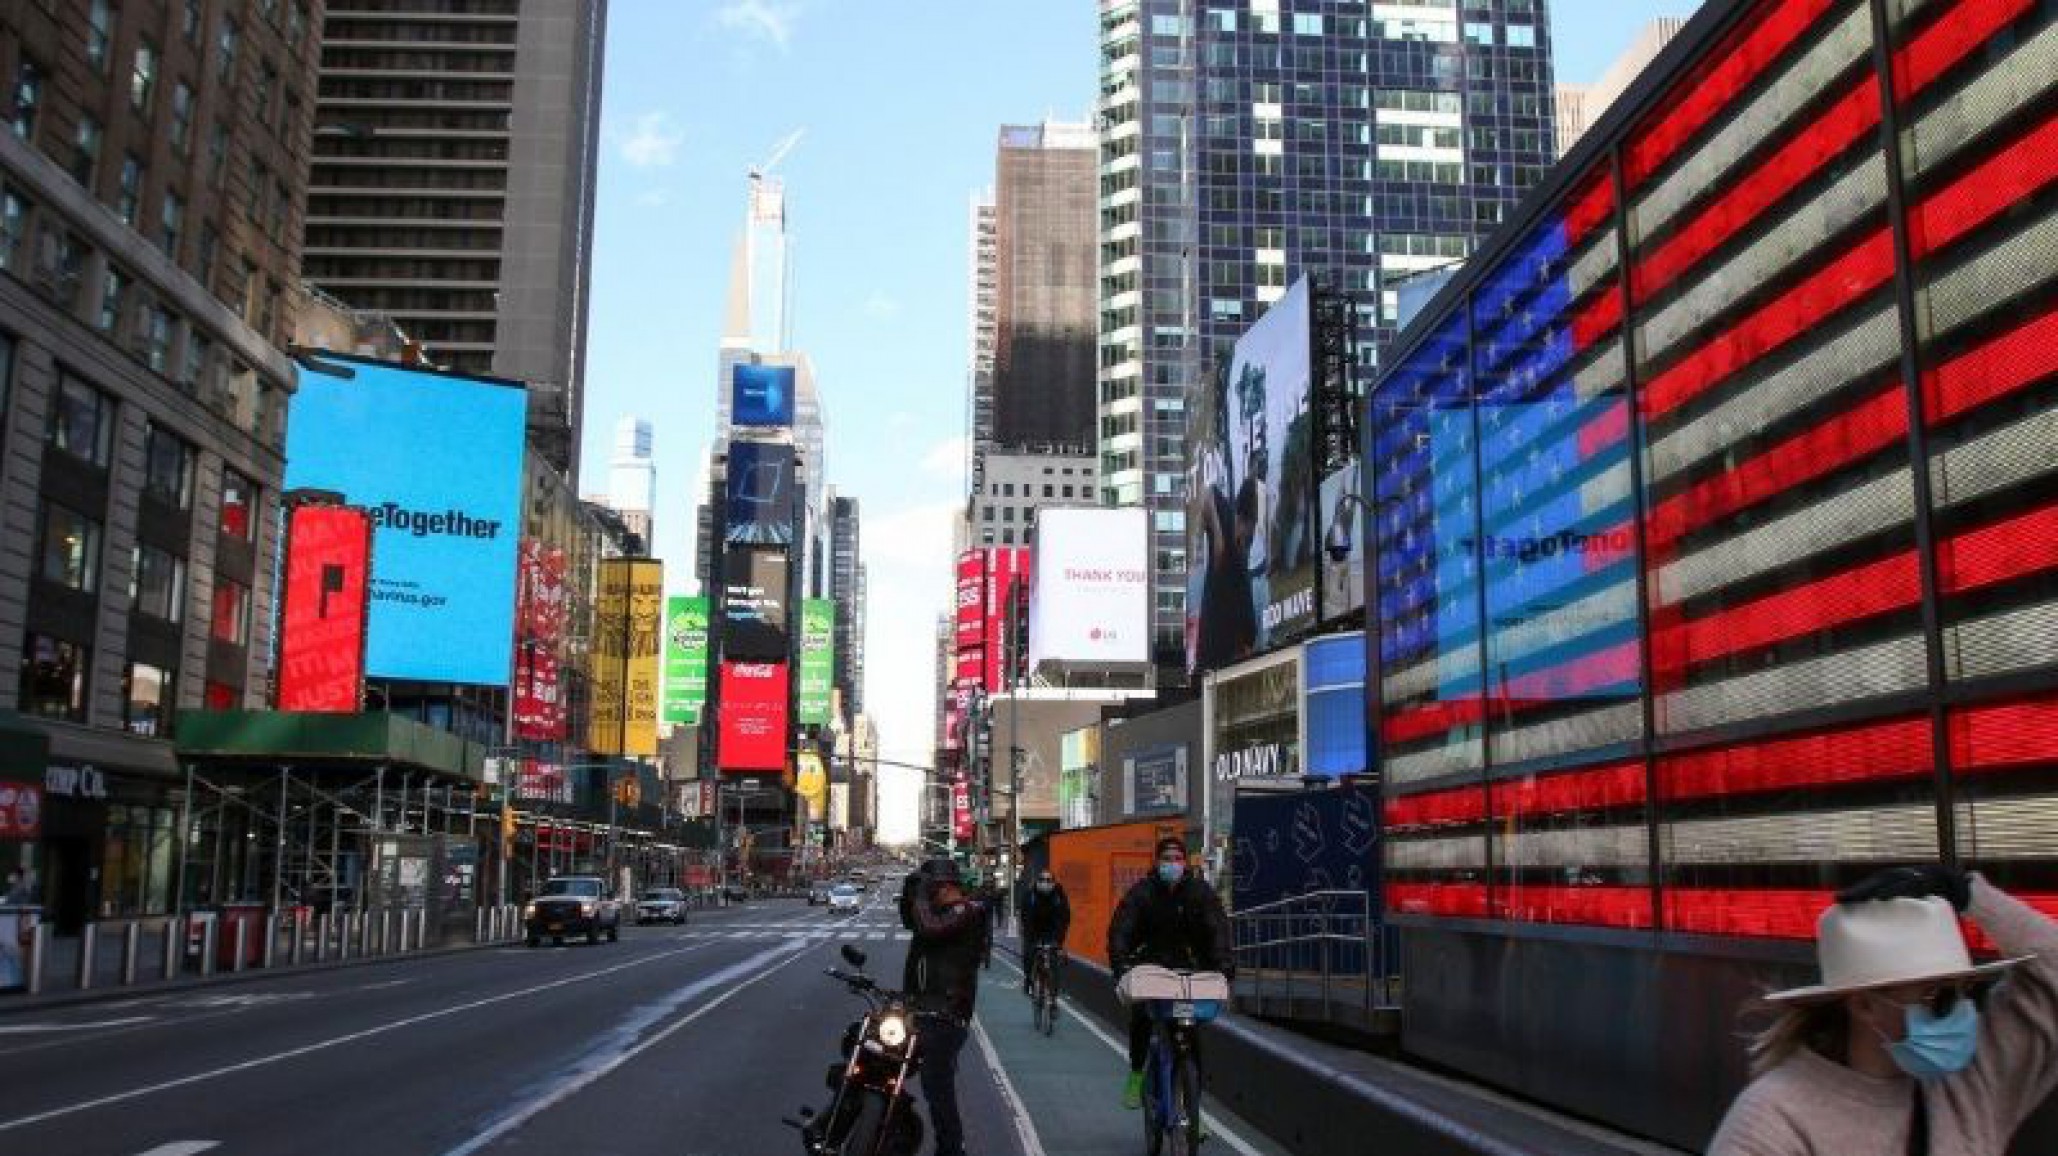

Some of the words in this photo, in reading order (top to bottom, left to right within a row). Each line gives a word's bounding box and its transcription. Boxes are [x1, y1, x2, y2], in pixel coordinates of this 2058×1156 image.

[1064, 569, 1112, 582] THANK
[1216, 750, 1241, 781] OLD
[1241, 742, 1281, 777] NAVY
